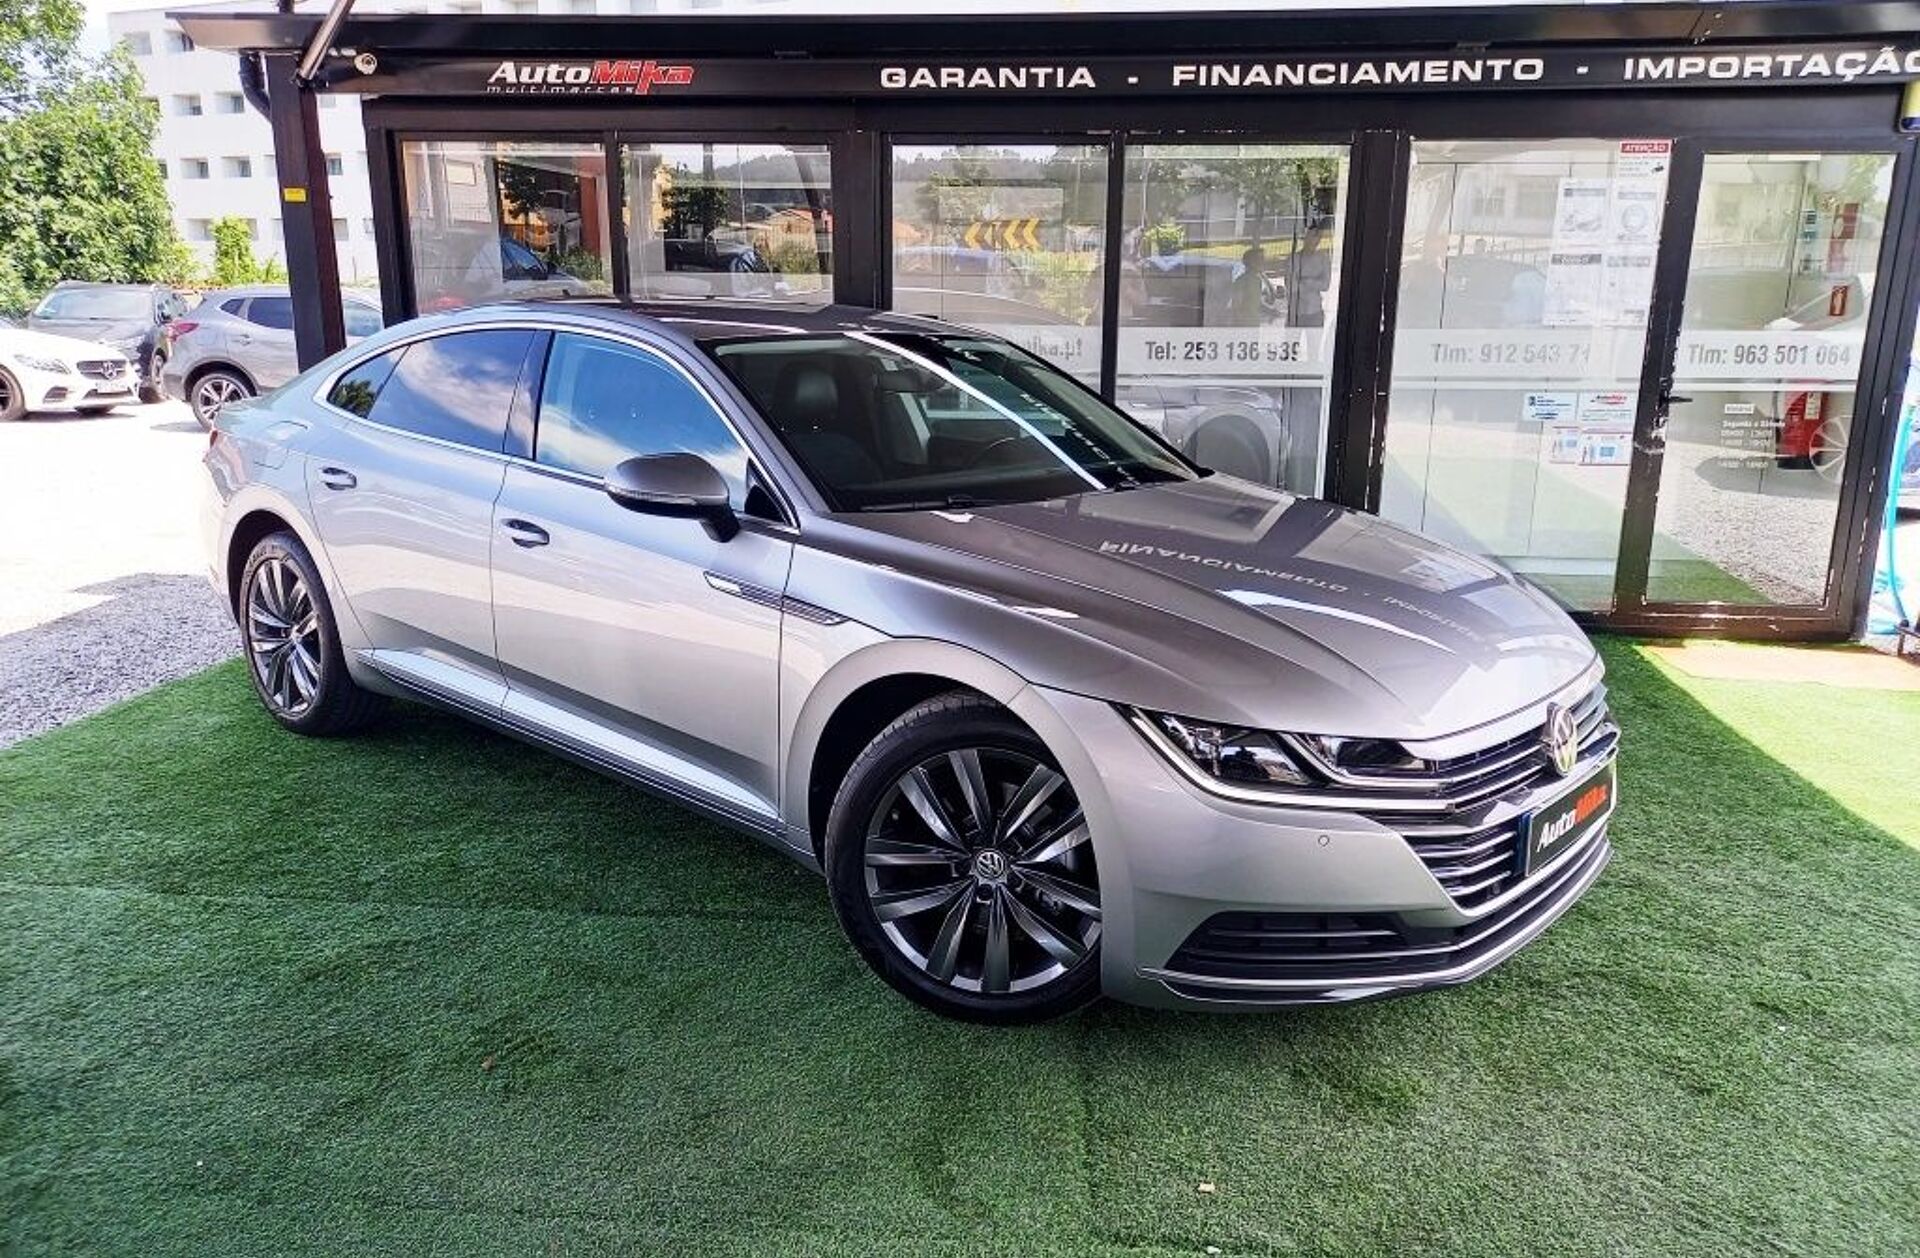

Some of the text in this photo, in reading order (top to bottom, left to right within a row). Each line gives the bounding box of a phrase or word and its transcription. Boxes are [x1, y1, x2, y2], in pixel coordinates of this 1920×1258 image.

[487, 60, 695, 95] AutoMika
[880, 67, 1097, 88] GARANTIA
[1172, 58, 1544, 87] FINANCIAMENTO
[1145, 341, 1177, 361] Tel:
[1183, 341, 1218, 361] 253
[1225, 341, 1259, 361] 136
[1432, 343, 1472, 363] Tlm:
[1480, 343, 1516, 363] 912
[1688, 344, 1850, 365] Tlm: 963 501 064
